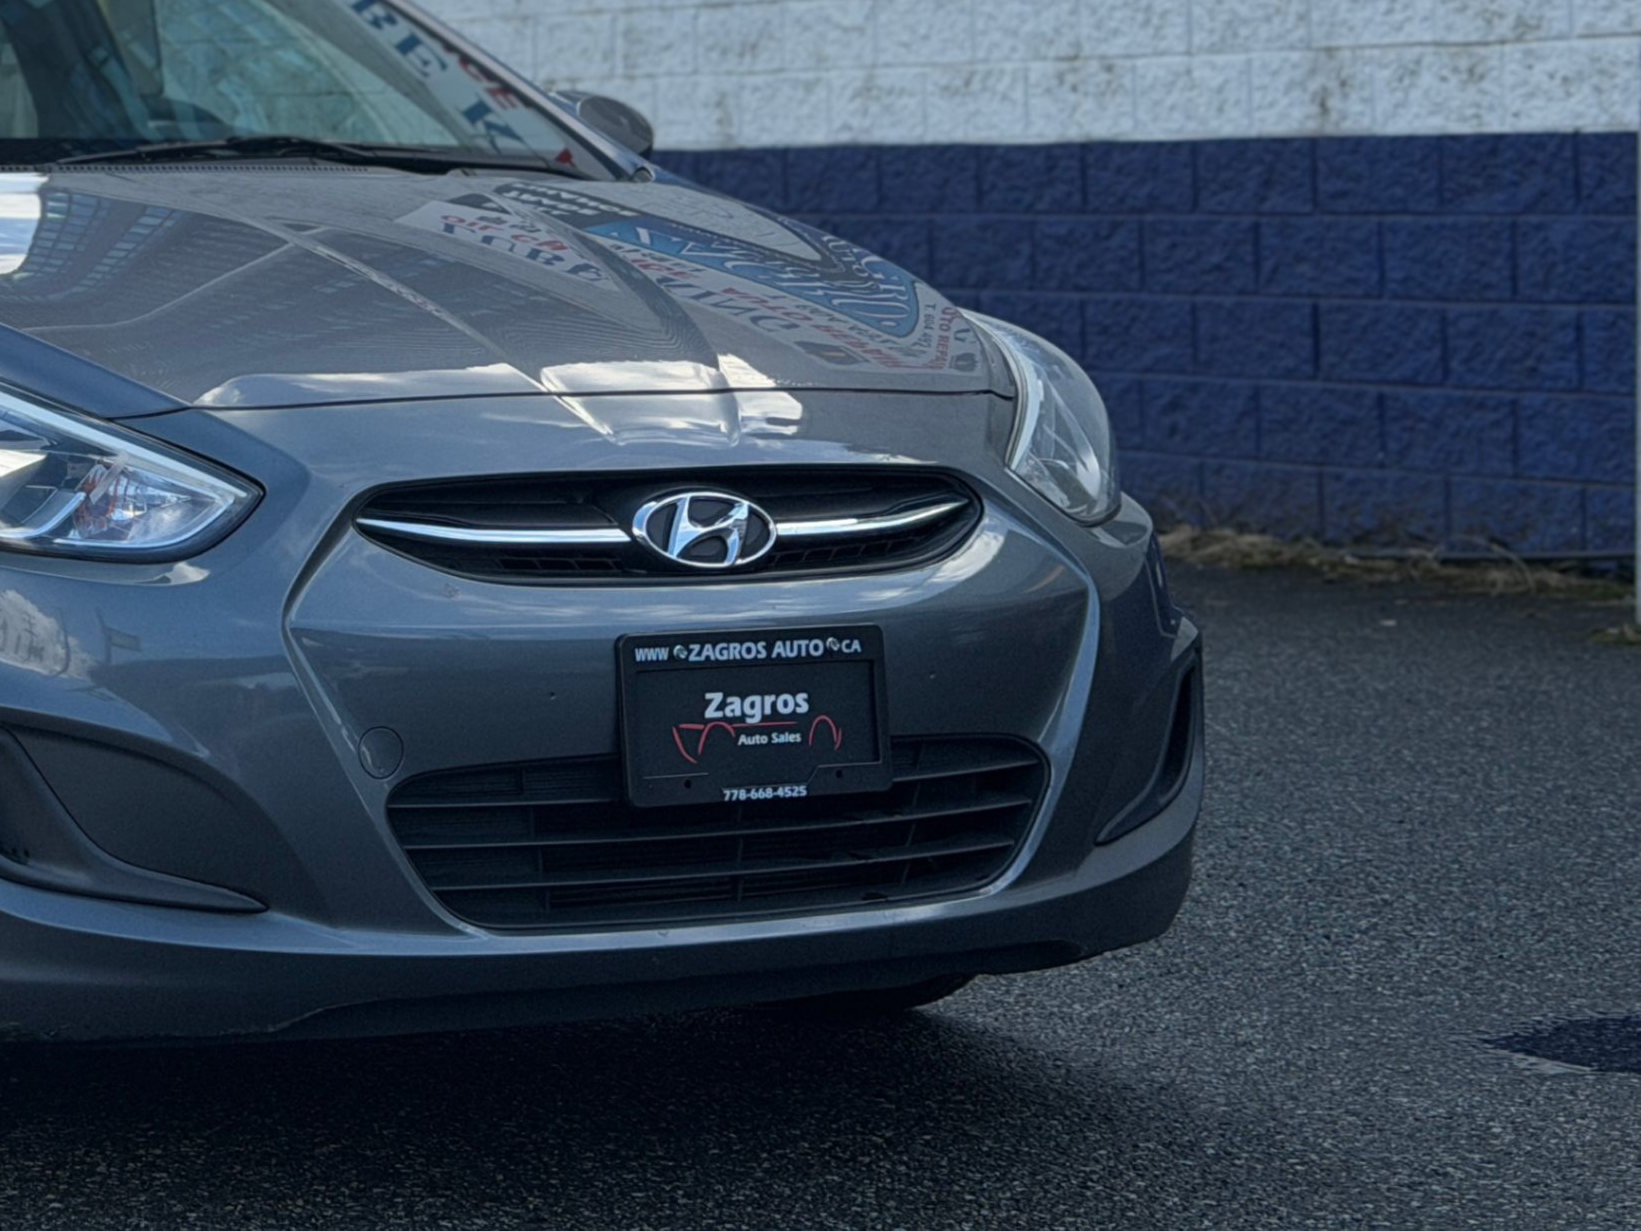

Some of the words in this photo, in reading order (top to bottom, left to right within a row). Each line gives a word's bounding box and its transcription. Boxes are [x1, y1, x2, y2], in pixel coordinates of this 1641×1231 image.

[635, 646, 669, 662] WWW
[688, 641, 766, 662] ZAGROS
[771, 639, 824, 658] AUTO
[841, 638, 862, 653] CA
[704, 692, 809, 724] Zagros
[737, 733, 768, 746] Auto
[771, 731, 801, 744] Sales
[723, 785, 807, 802] 778-668-4525
